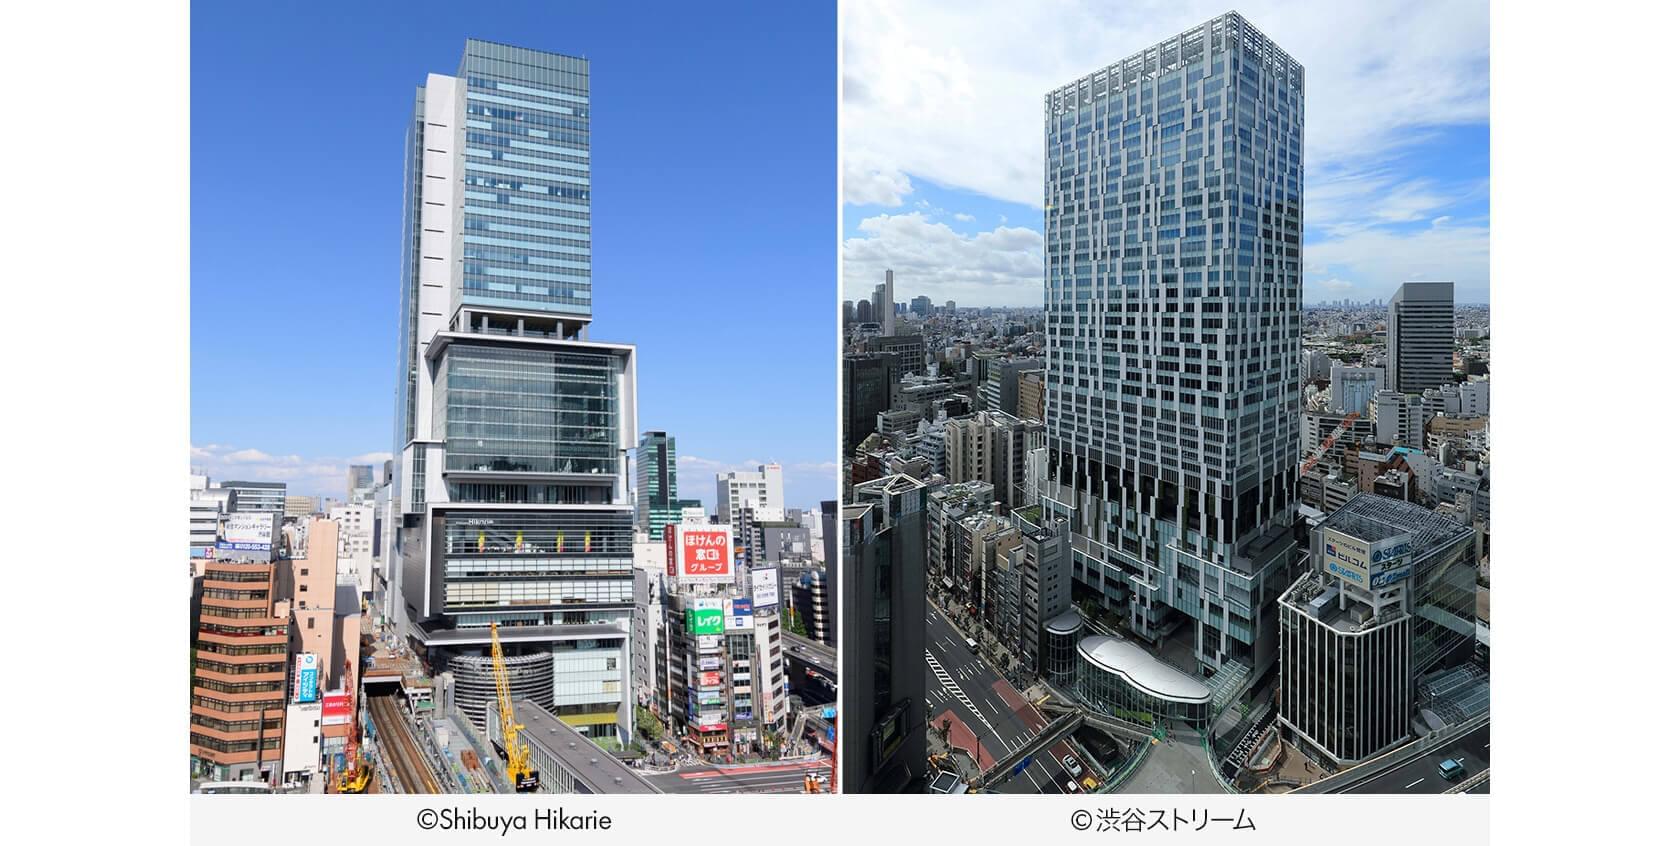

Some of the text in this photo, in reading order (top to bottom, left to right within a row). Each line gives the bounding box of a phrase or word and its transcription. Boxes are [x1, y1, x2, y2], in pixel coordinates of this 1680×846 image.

[685, 535, 726, 547] ほけんの
[1338, 552, 1368, 570] ビルコム
[690, 563, 723, 572] グループ
[697, 616, 721, 627] レイク
